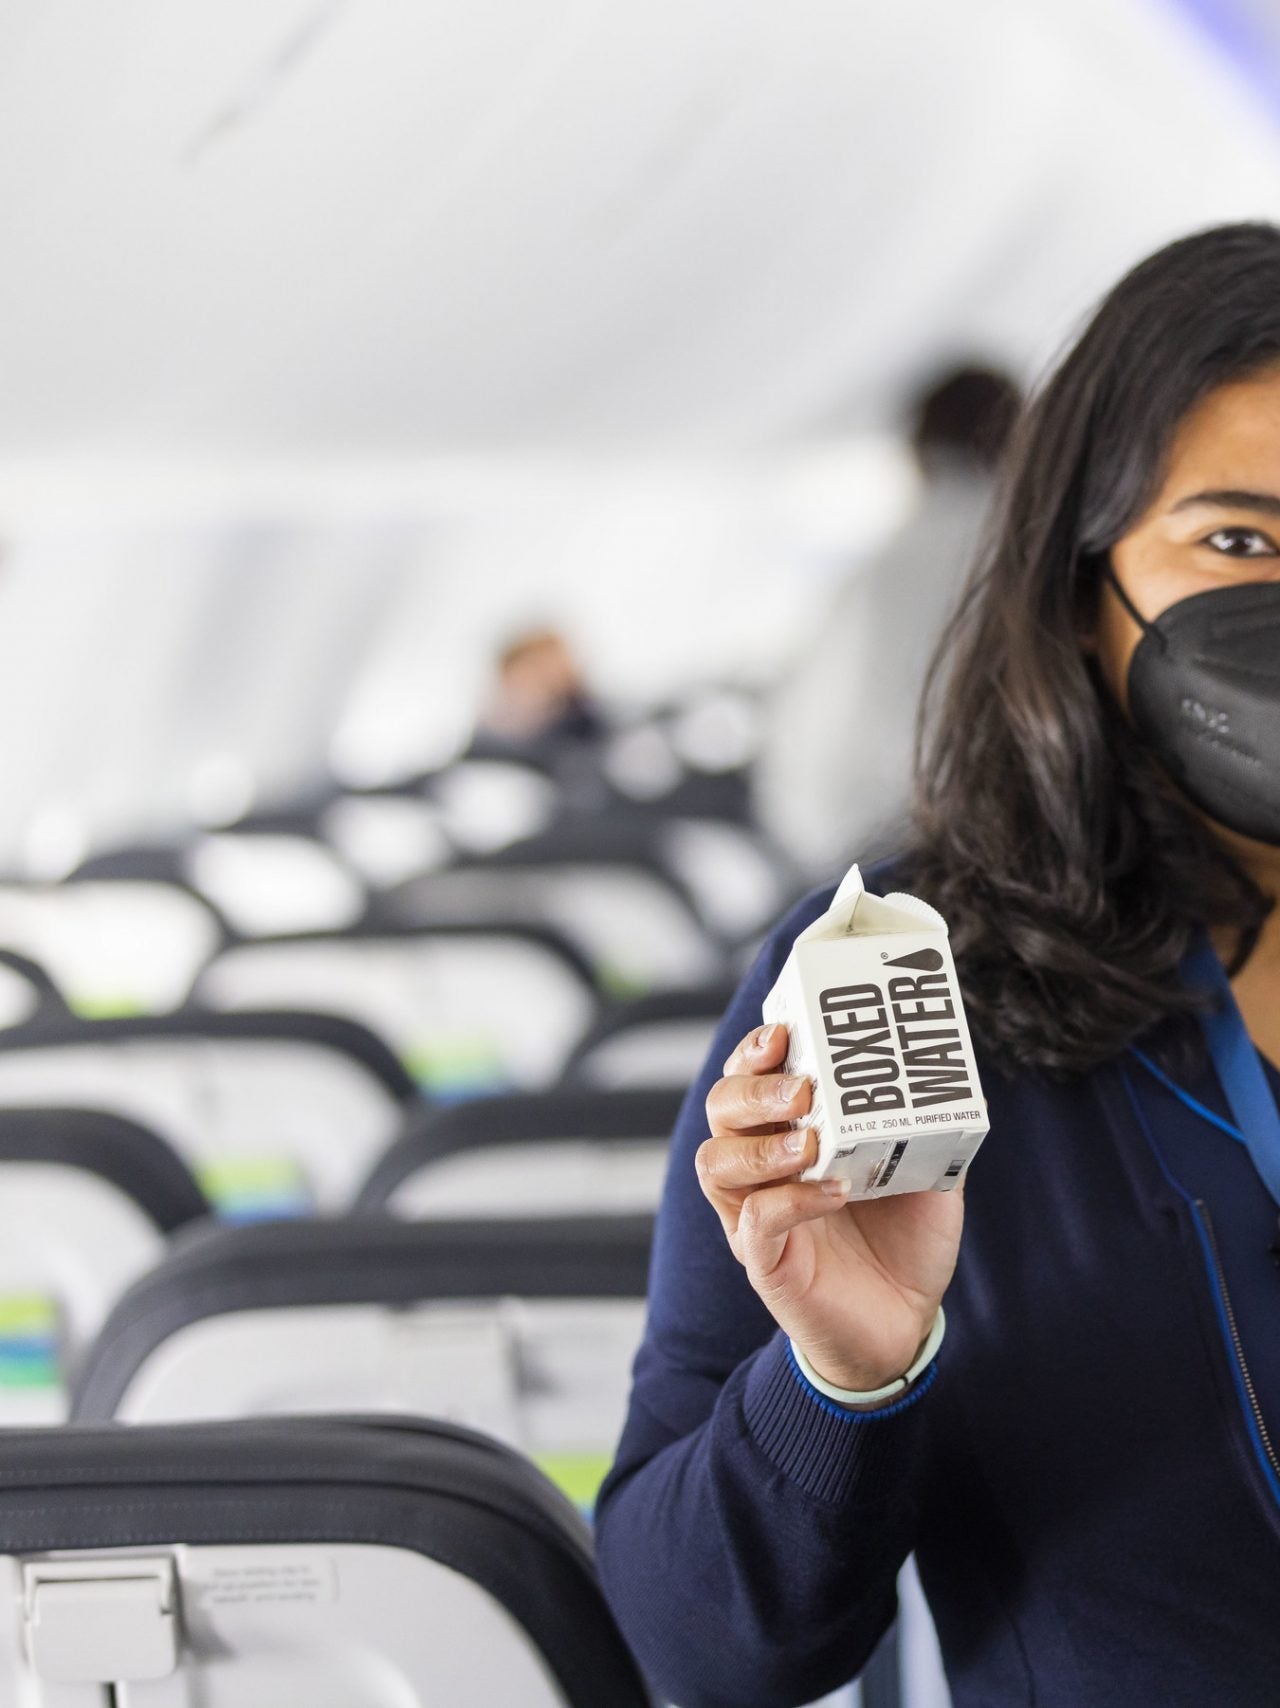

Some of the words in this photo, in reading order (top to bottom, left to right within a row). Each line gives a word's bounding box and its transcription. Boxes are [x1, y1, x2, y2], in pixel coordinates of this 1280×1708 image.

[819, 983, 906, 1116] BOXED
[888, 973, 973, 1109] WATER
[840, 1124, 853, 1134] 8.4
[855, 1123, 865, 1132] FL
[866, 1121, 877, 1130] OZ
[882, 1118, 897, 1129] 250
[899, 1117, 912, 1127] ML
[915, 1113, 952, 1126] PURIFIED
[954, 1110, 981, 1121] WATER
